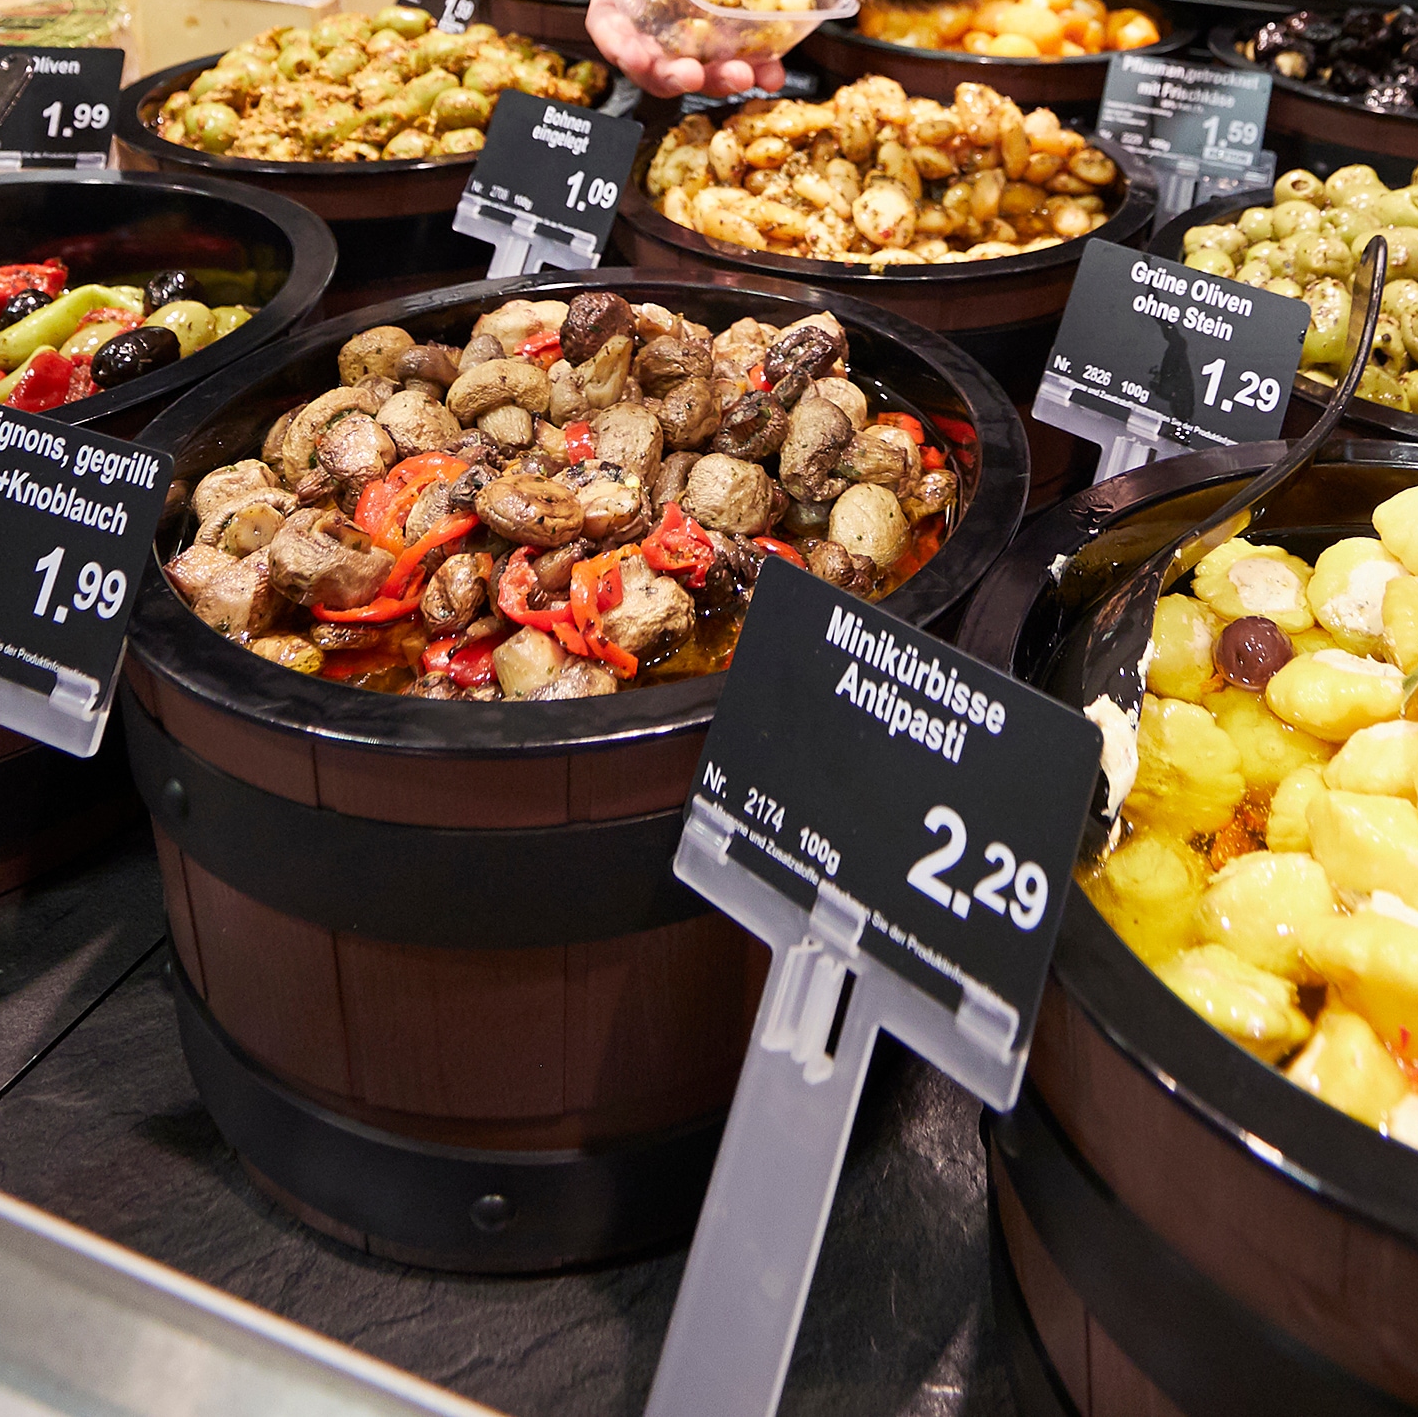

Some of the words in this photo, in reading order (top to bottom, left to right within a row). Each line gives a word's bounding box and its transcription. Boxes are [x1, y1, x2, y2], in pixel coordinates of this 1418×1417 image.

[42, 100, 111, 138] 1.99
[532, 123, 590, 155] eingelegt
[542, 105, 592, 135] Bohnen
[1202, 115, 1259, 148] 1.59
[566, 170, 619, 212] 1.09
[1130, 261, 1187, 296] Grüne
[1190, 279, 1253, 317] Oliven
[1132, 293, 1180, 323] ohne
[1182, 307, 1233, 341] Stein
[1053, 354, 1072, 374] Nr.
[1082, 364, 1112, 387] 2826
[1121, 381, 1150, 403] 100g
[1201, 358, 1281, 413] 1.29
[73, 444, 161, 490] gegrillt
[33, 546, 127, 625] 1.99
[3, 642, 17, 657] der
[825, 604, 1007, 735] Minikürbisse
[834, 662, 969, 764] Antipasti
[702, 761, 727, 799] Nr.
[743, 786, 786, 833] 2174
[798, 826, 841, 877] 100g
[748, 824, 766, 847] und
[870, 909, 887, 932] Sie
[887, 921, 906, 946] der
[906, 805, 1049, 932] 2.29
